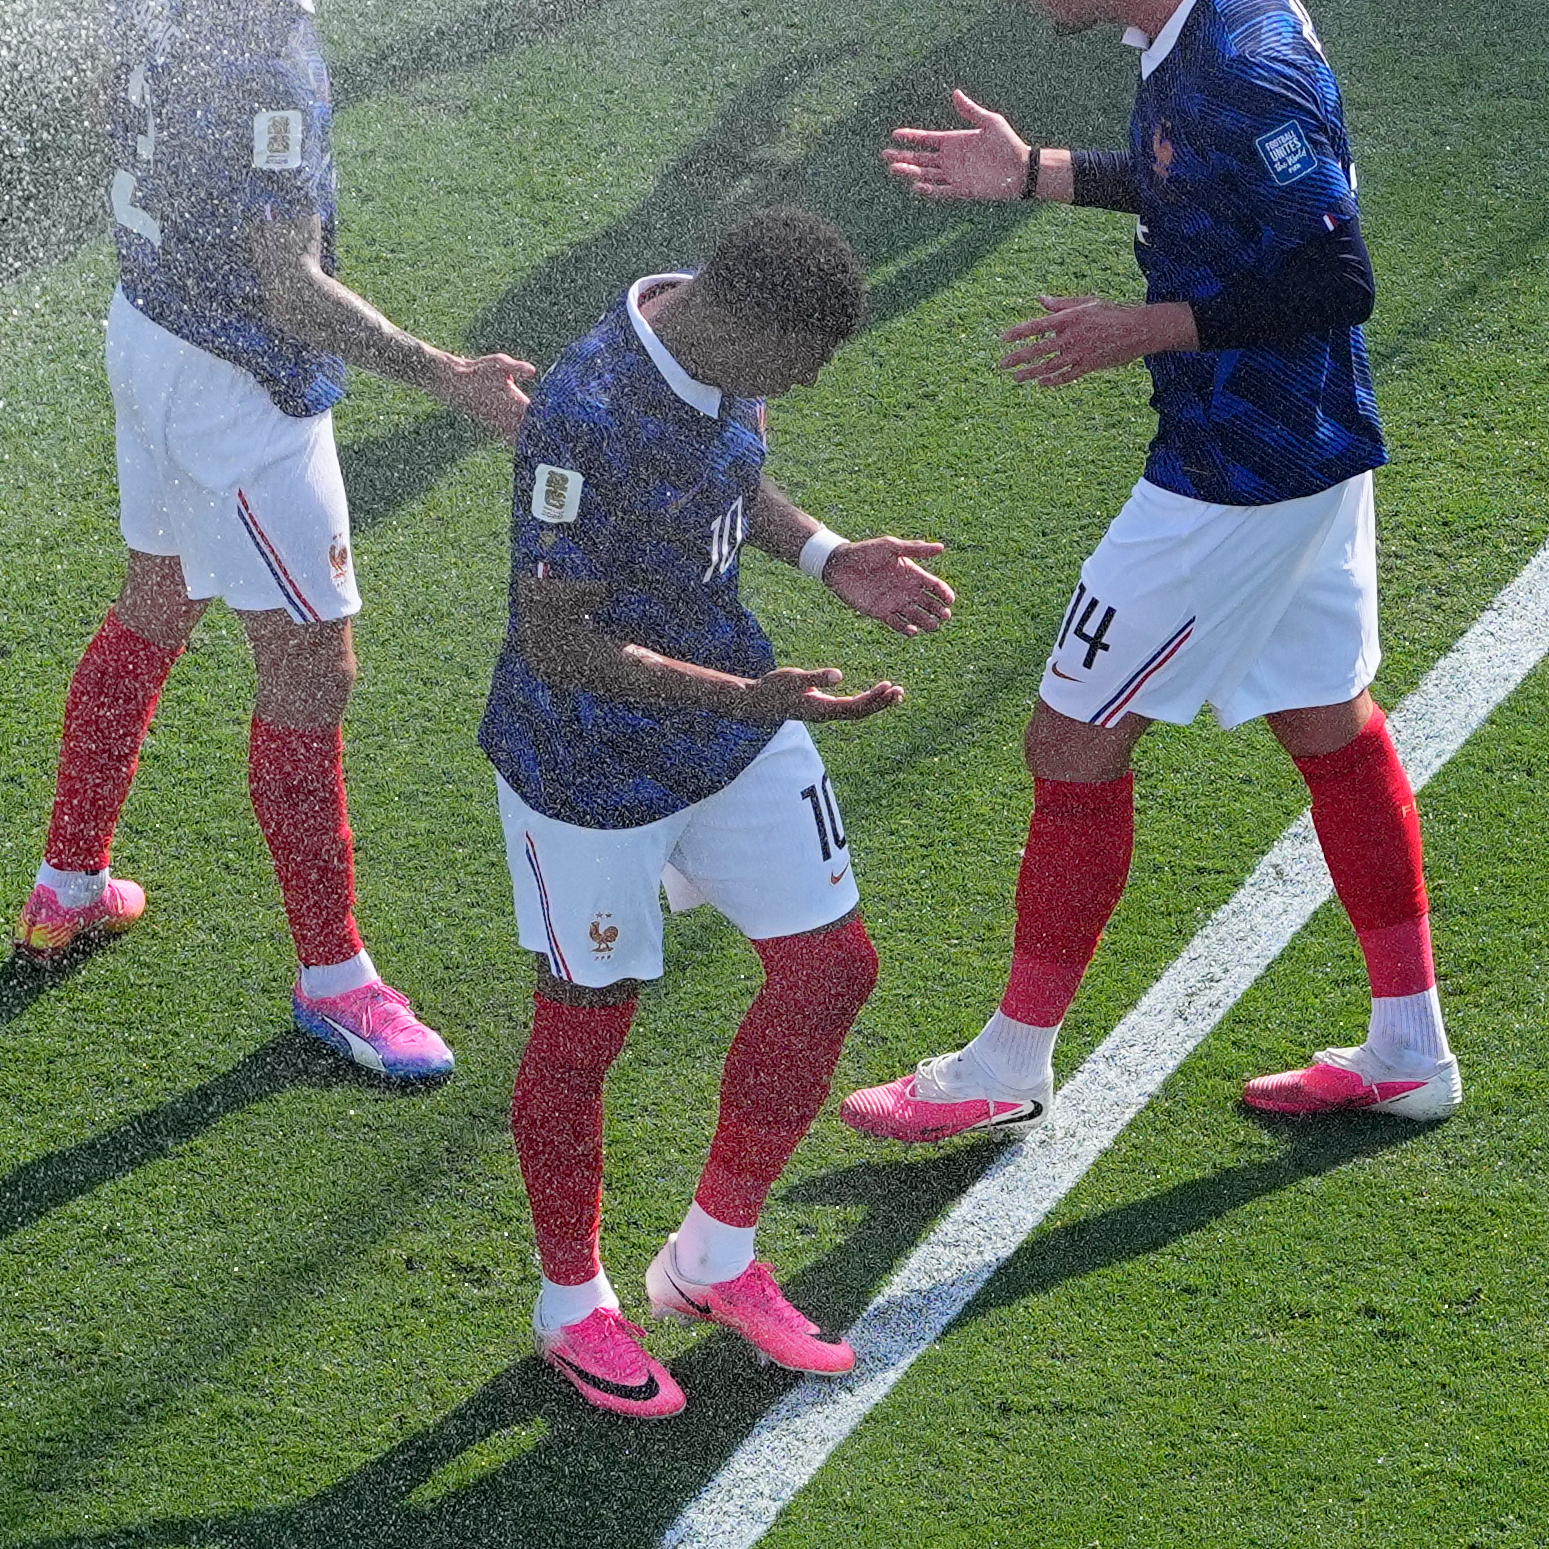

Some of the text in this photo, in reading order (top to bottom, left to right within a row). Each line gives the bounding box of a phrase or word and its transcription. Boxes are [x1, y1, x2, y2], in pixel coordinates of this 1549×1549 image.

[1269, 137, 1301, 162] UNITES
[702, 495, 743, 584] 10
[1058, 582, 1117, 670] 14
[800, 772, 846, 862] 10
